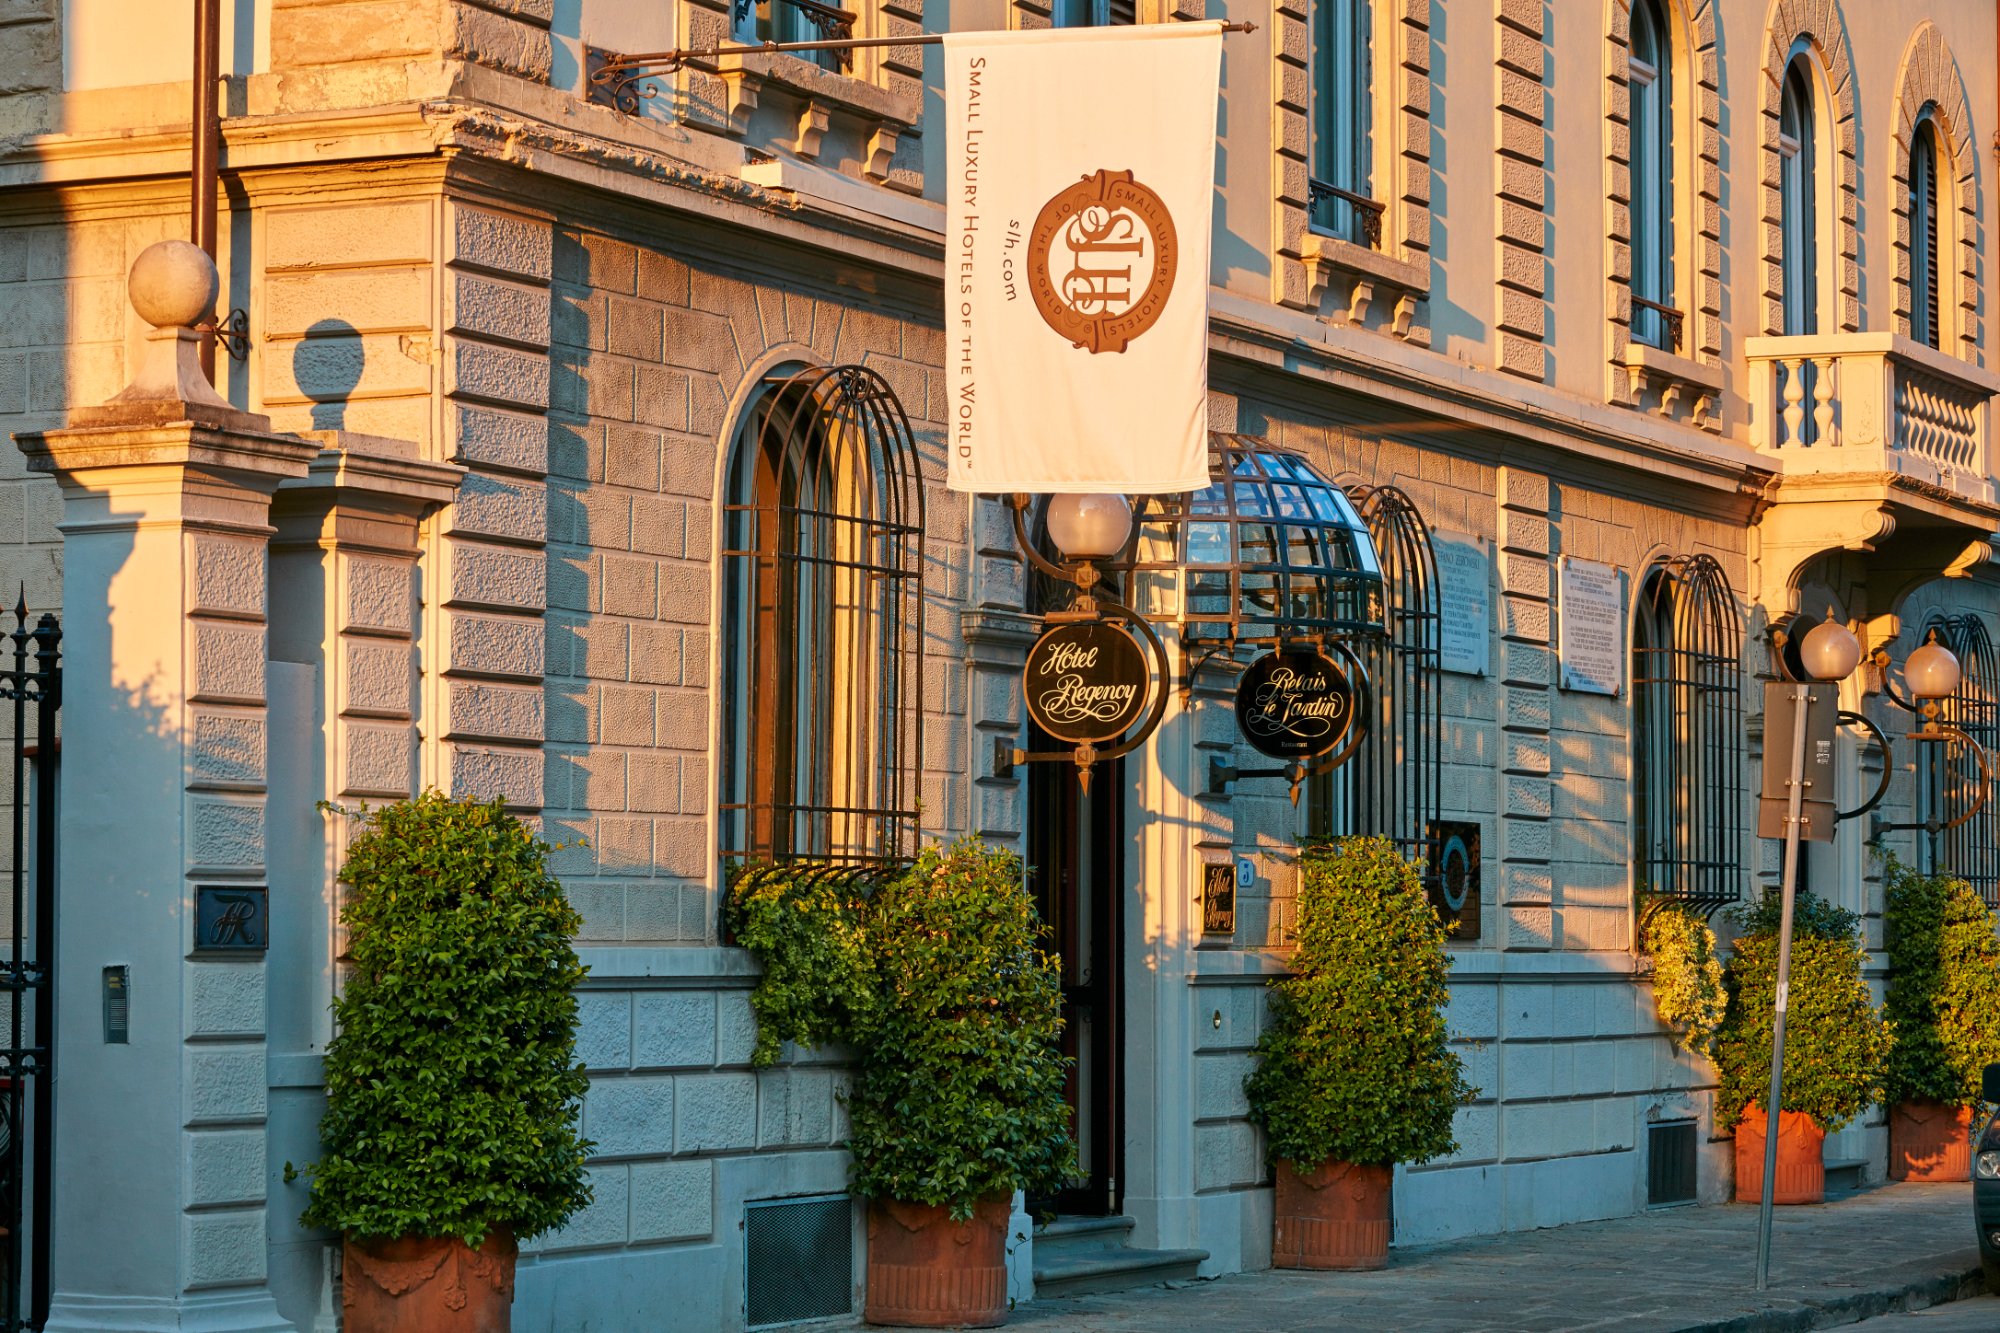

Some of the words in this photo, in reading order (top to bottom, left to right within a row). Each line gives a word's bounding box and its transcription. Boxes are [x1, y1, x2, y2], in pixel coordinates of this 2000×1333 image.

[1055, 203, 1071, 221] OF
[1115, 188, 1156, 221] SMALL
[1036, 225, 1053, 254] THE
[1156, 222, 1168, 287] LUXURY
[1002, 219, 1021, 302] slh.com
[1110, 294, 1160, 335] HOTELS
[1040, 642, 1098, 675] Hotel
[1039, 673, 1137, 723] Regency
[1256, 667, 1327, 707] Relais
[1281, 691, 1344, 730] Jardin
